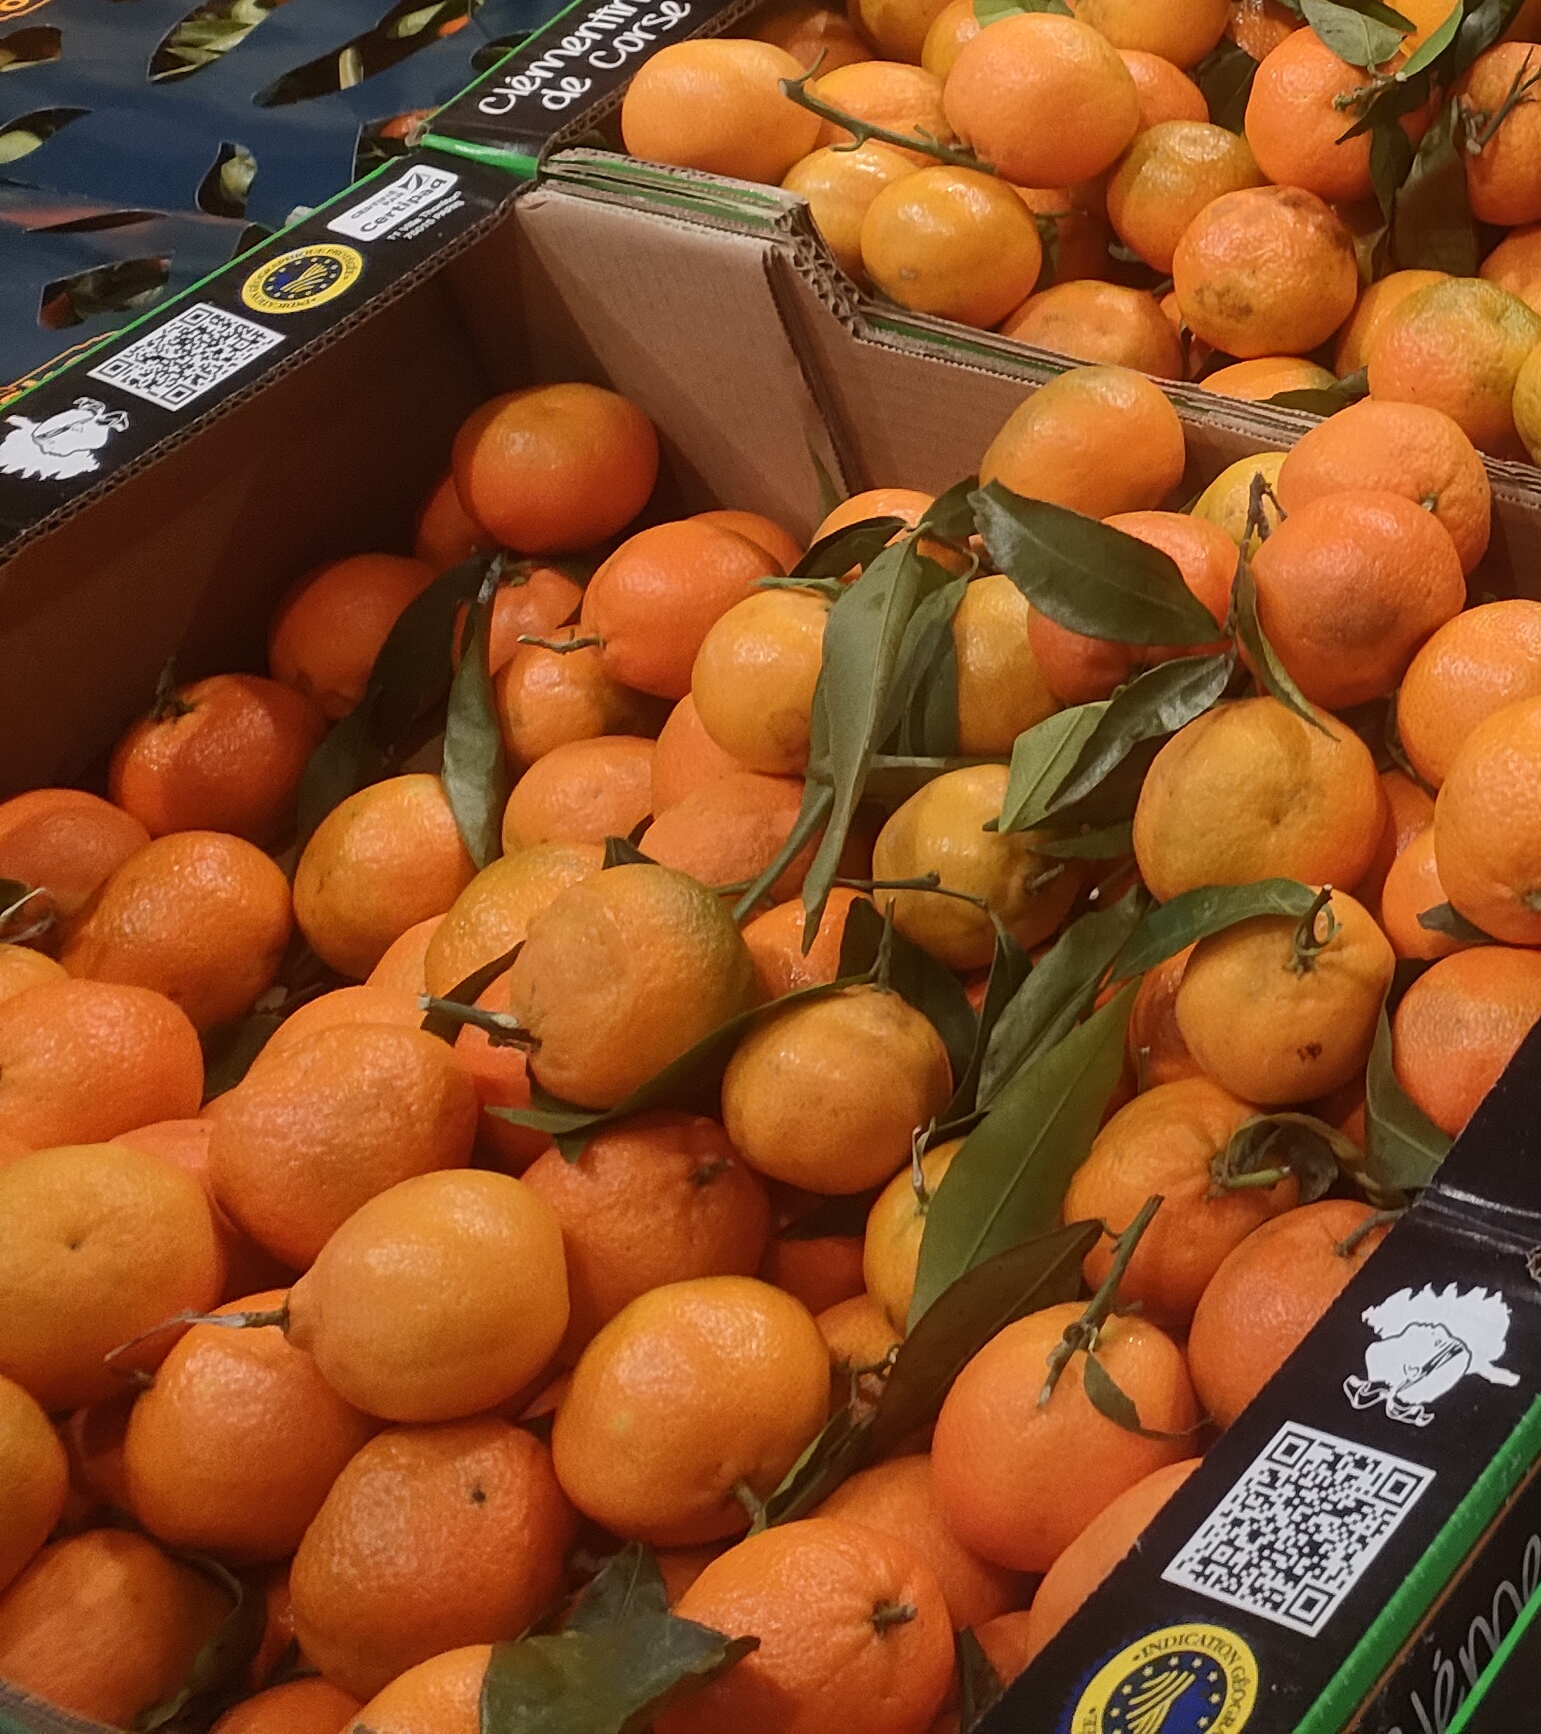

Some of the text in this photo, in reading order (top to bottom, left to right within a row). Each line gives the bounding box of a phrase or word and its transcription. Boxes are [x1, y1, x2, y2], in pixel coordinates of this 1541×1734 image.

[541, 0, 691, 111] de Corse
[360, 178, 448, 232] Certipaq
[1142, 1633, 1241, 1665] INDICATION
